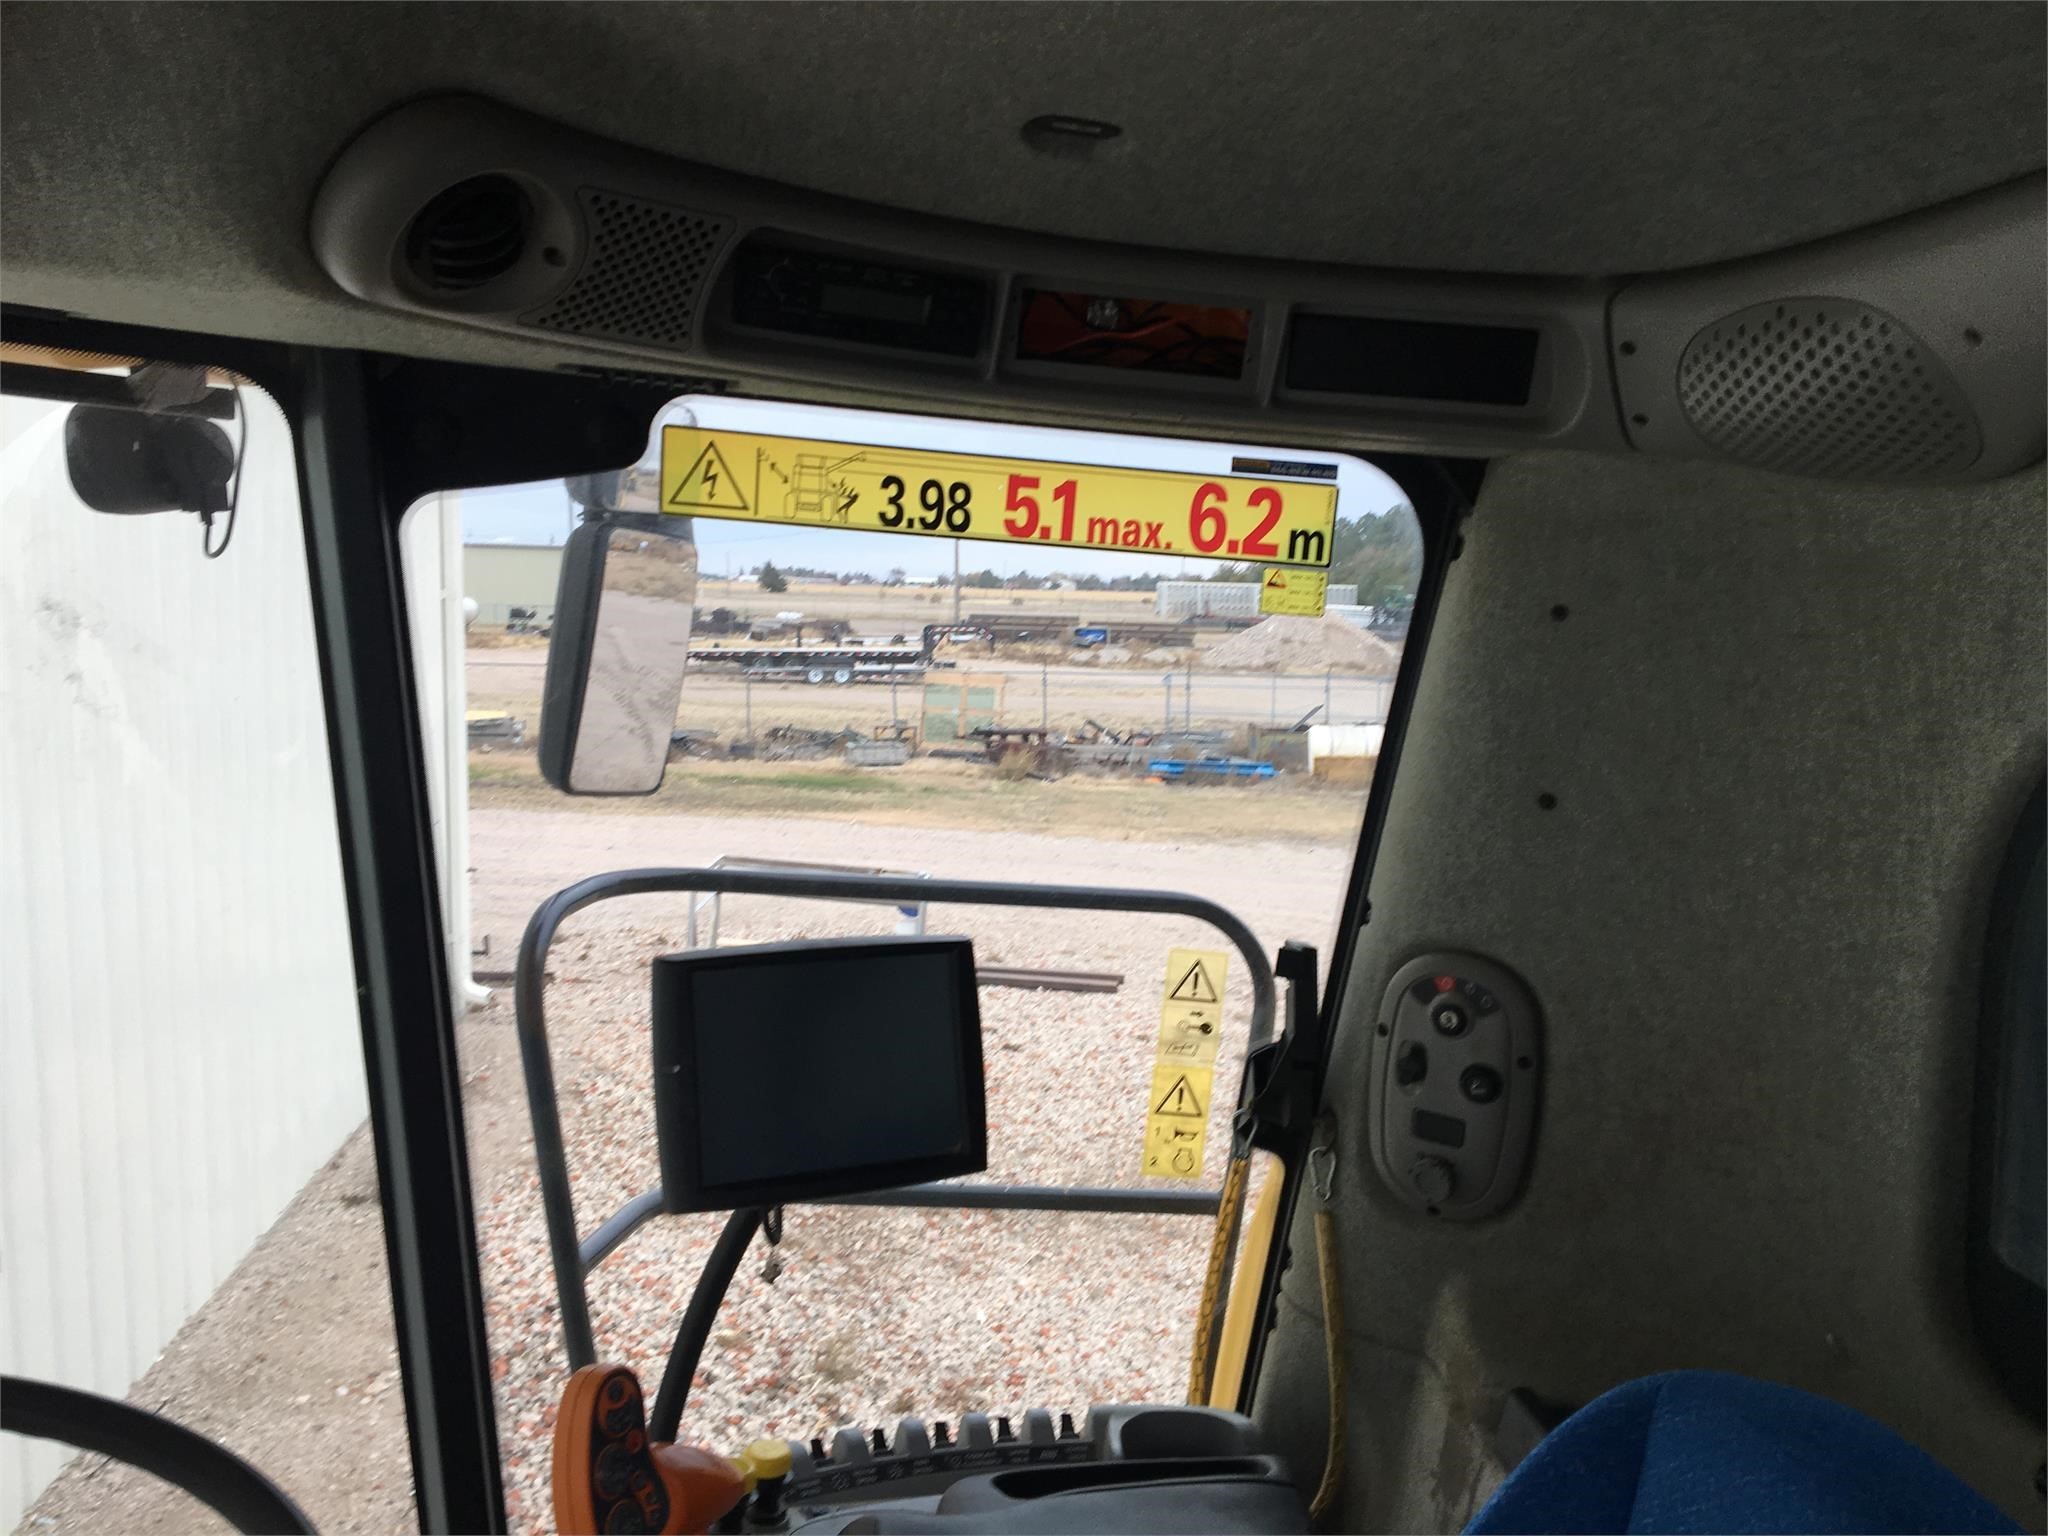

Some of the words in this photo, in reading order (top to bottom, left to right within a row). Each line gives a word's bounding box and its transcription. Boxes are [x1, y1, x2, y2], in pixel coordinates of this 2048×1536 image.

[878, 475, 972, 533] 3.98
[1003, 473, 1078, 542] 5.1
[1086, 517, 1173, 550] max.
[1188, 481, 1284, 557] 6.2
[1287, 529, 1326, 562] m
